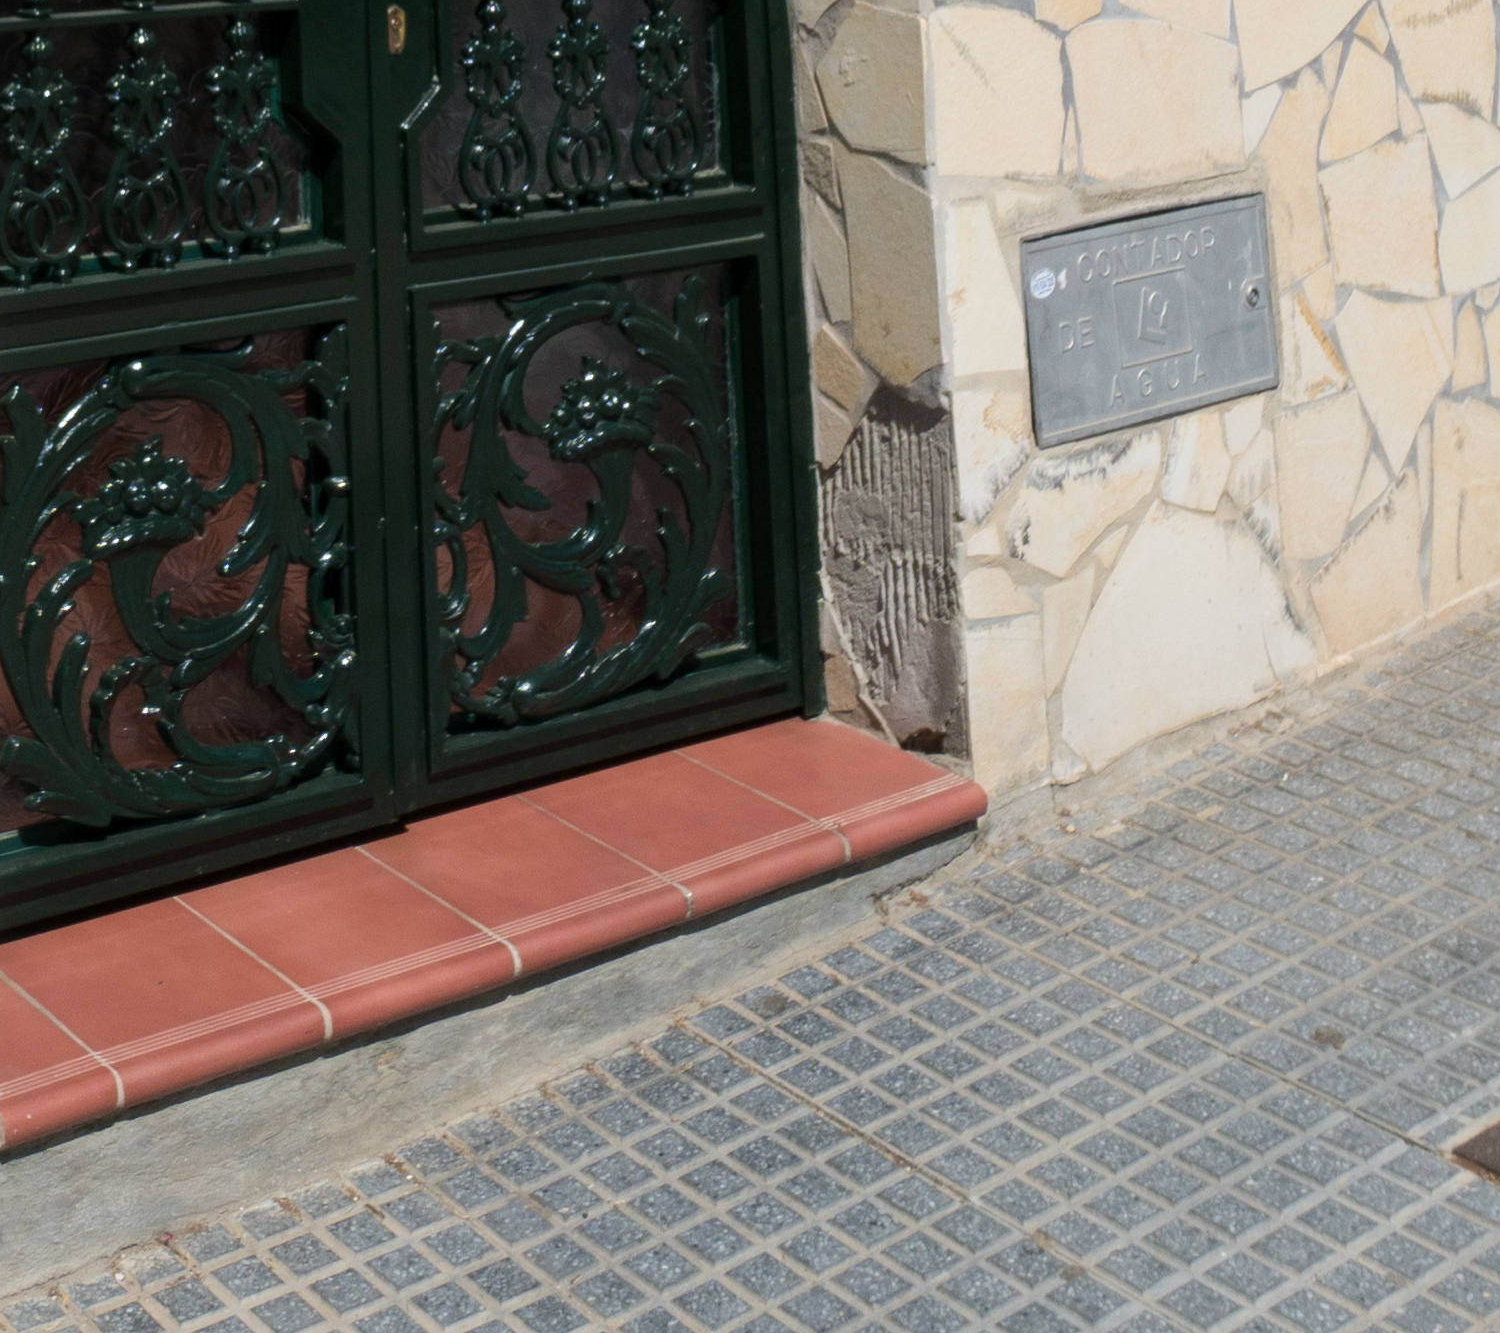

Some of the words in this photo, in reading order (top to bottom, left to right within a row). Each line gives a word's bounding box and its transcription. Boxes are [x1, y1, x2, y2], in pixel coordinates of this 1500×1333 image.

[1076, 225, 1218, 284] CONTADOR
[1059, 315, 1095, 354] DE
[1108, 352, 1206, 408] AGUA
